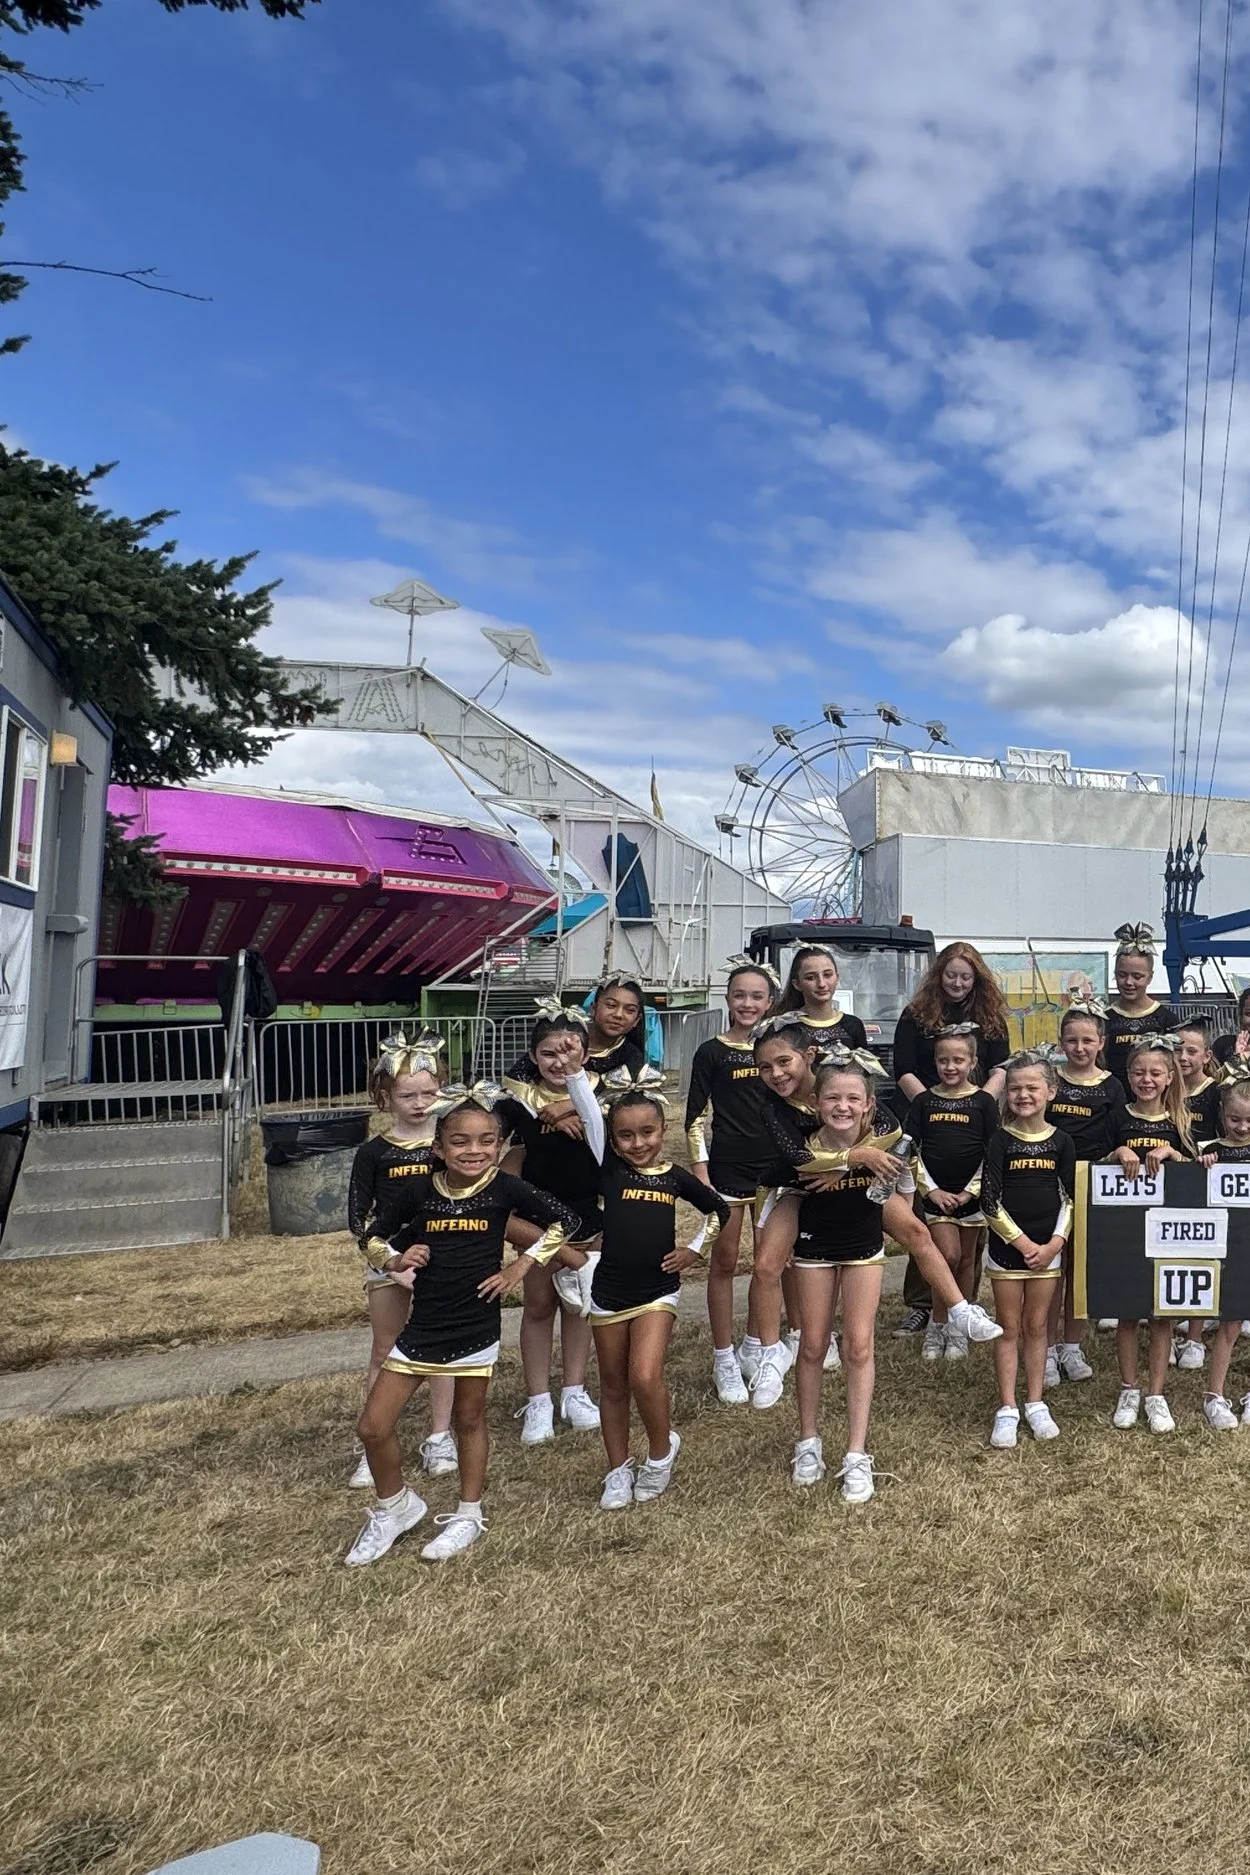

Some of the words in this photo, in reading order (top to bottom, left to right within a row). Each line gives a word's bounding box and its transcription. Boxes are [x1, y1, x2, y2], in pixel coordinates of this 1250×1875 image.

[732, 1067, 760, 1080] INFE
[1052, 1103, 1092, 1117] INFERNO
[929, 1113, 970, 1124] INFERNO
[1126, 1137, 1171, 1148] INFERNO
[1008, 1158, 1056, 1170] INFERNO
[388, 1164, 433, 1179] INFER
[1101, 1174, 1157, 1197] LETS
[622, 1188, 676, 1206] INFERNO
[425, 1219, 489, 1232] INFERNO
[1160, 1221, 1216, 1241] FIRED
[1163, 1270, 1212, 1306] UP
